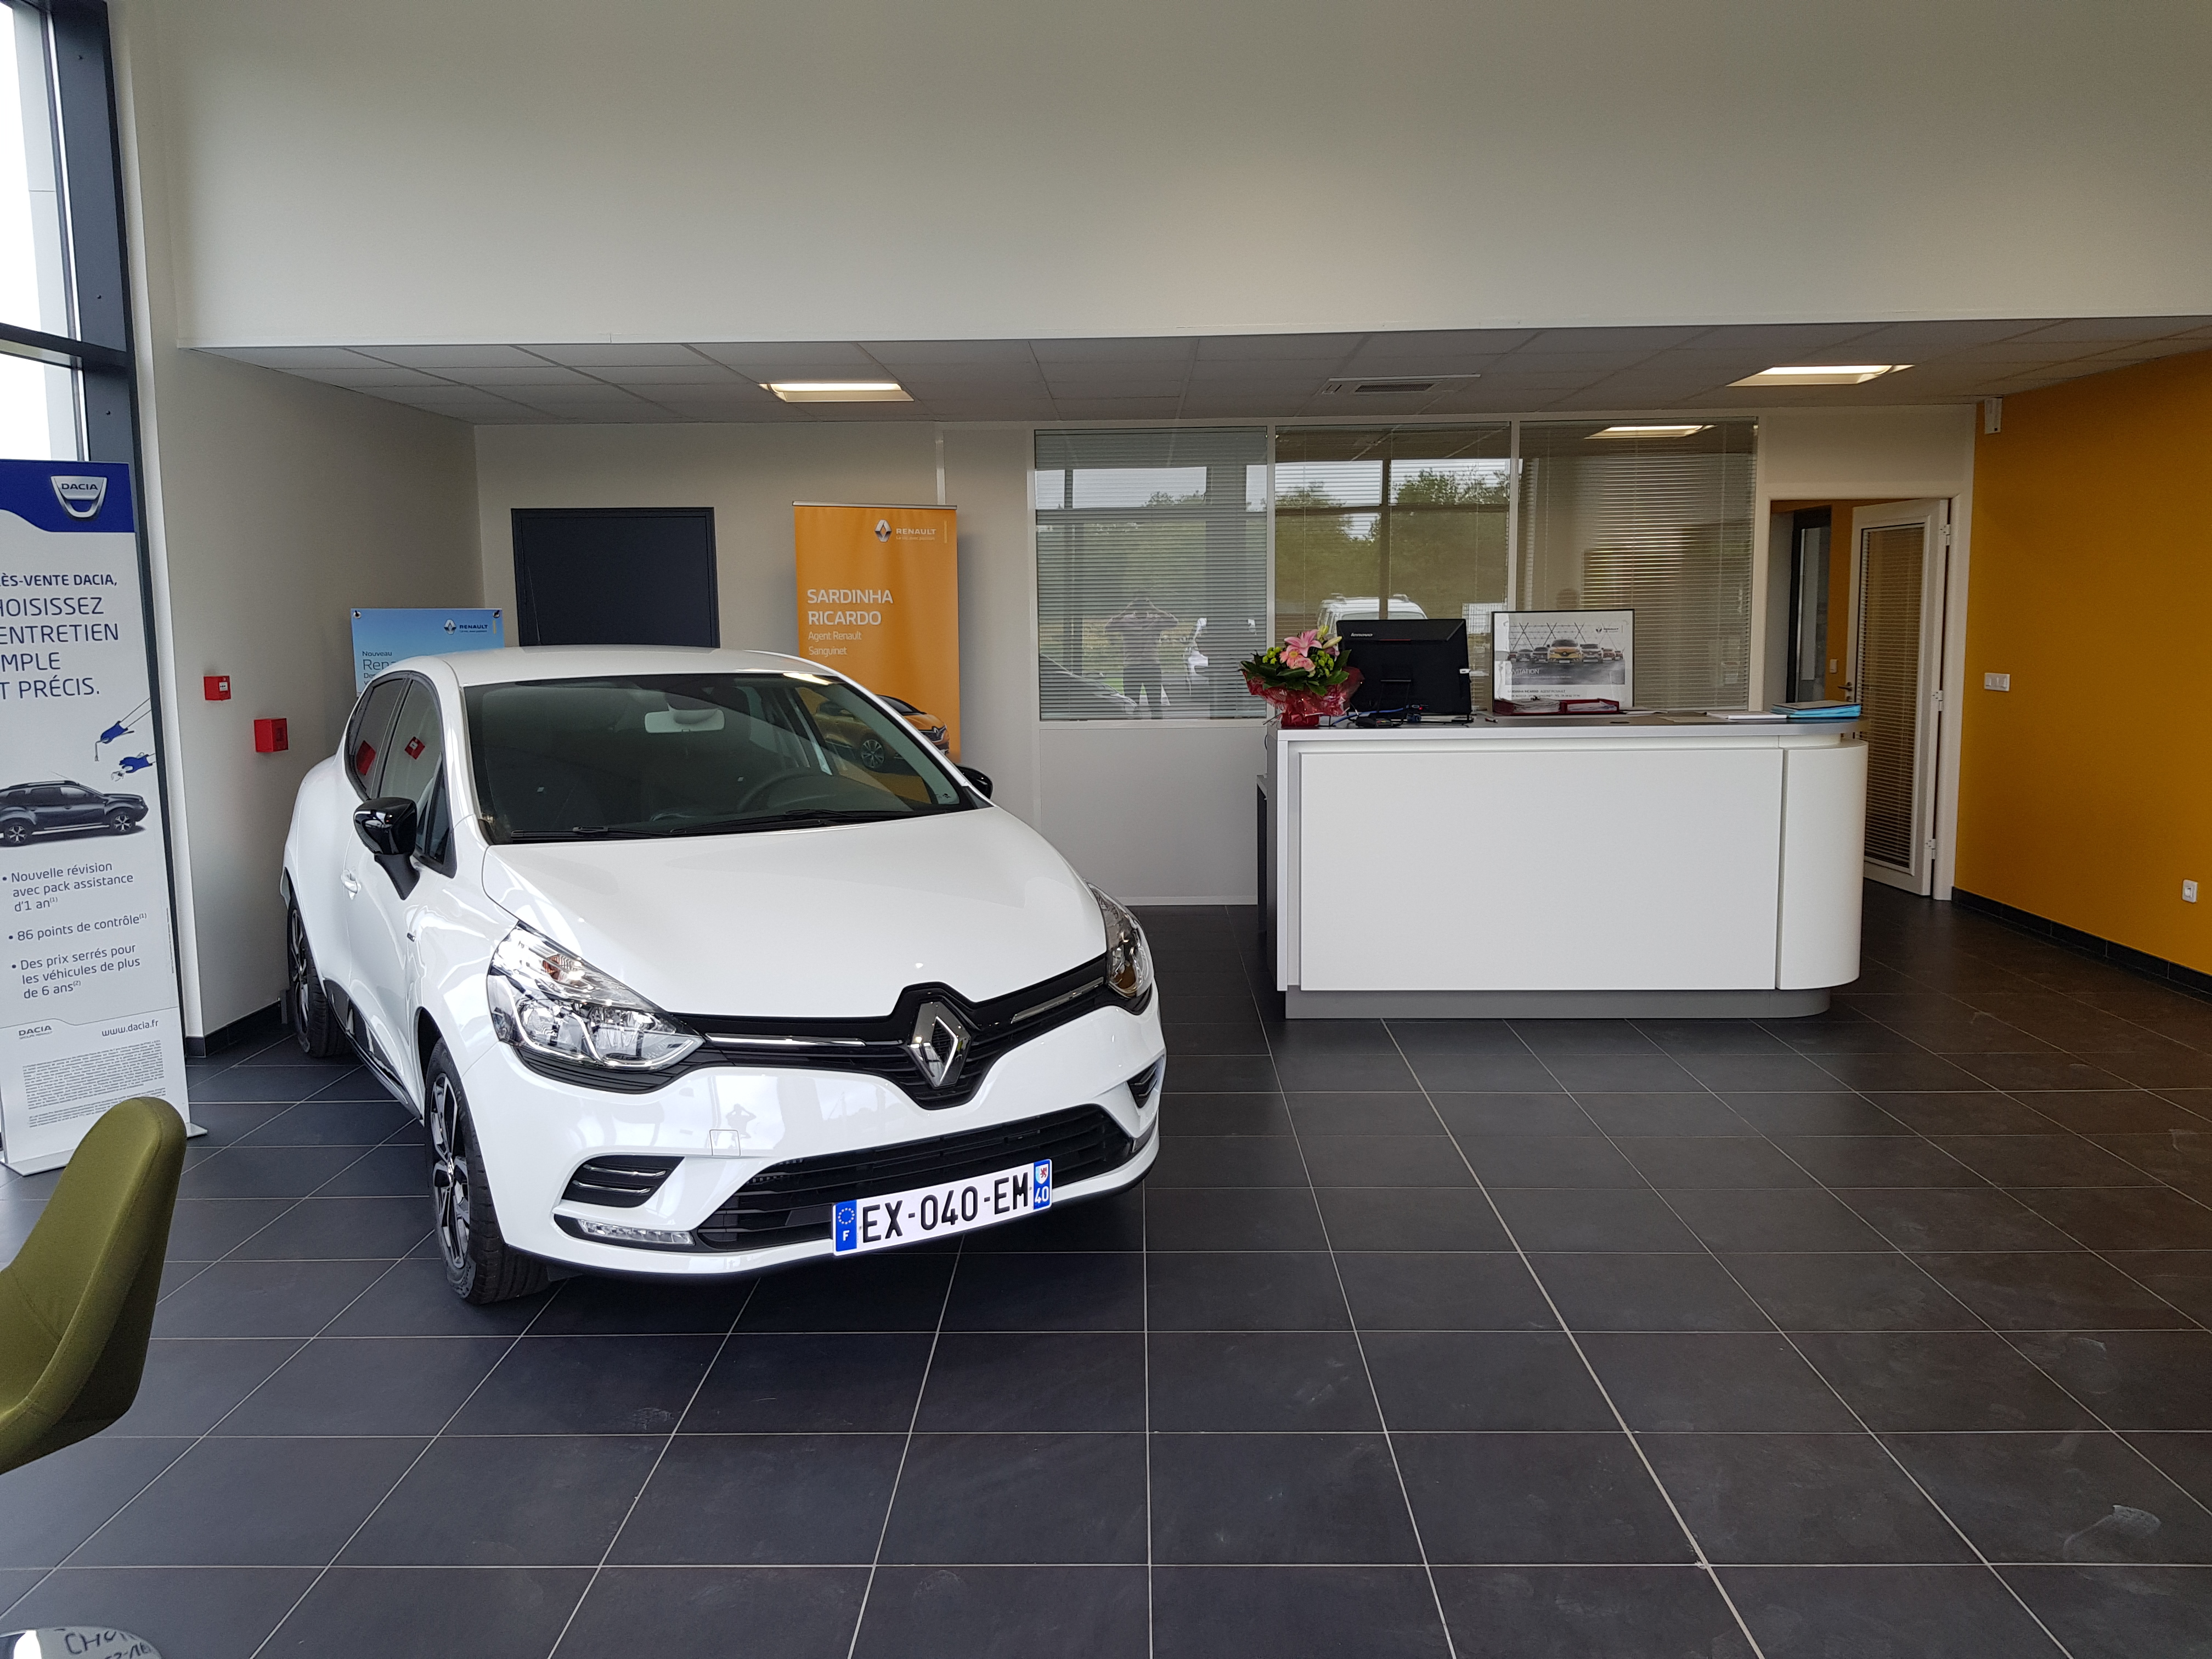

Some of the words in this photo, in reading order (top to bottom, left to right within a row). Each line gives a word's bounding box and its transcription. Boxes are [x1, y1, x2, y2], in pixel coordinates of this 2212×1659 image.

[0, 572, 69, 586] ÈS-VENTE
[74, 574, 117, 586] DACIA,
[807, 589, 894, 603] SARDINHA
[0, 597, 104, 617] OISISSEZ
[808, 611, 882, 625] RICARDO
[808, 631, 832, 642] Agent
[833, 630, 862, 640] Renault
[809, 646, 848, 658] Sanguinet
[19, 674, 100, 699] PRÉCIS.
[11, 867, 64, 883] Nouvelle
[67, 862, 112, 876] révision
[13, 886, 40, 898] avec
[43, 881, 70, 895] pack
[74, 874, 133, 889] assistance
[18, 929, 33, 941] 86
[37, 925, 73, 940] points
[77, 922, 91, 932] de
[21, 959, 43, 970] Des
[47, 954, 69, 968] prix
[72, 948, 107, 962] serrés
[111, 945, 136, 958] pour
[22, 974, 39, 984] les
[43, 965, 97, 981] véhicules
[100, 962, 114, 972] de
[117, 958, 140, 971] plus
[24, 988, 38, 999] de
[42, 985, 49, 996] 6
[19, 1025, 52, 1036] DACIA
[101, 1019, 159, 1037] www.dacia.fr
[842, 1229, 850, 1242] F
[862, 1171, 1029, 1243] EX-040-EM
[1034, 1185, 1050, 1204] 40
